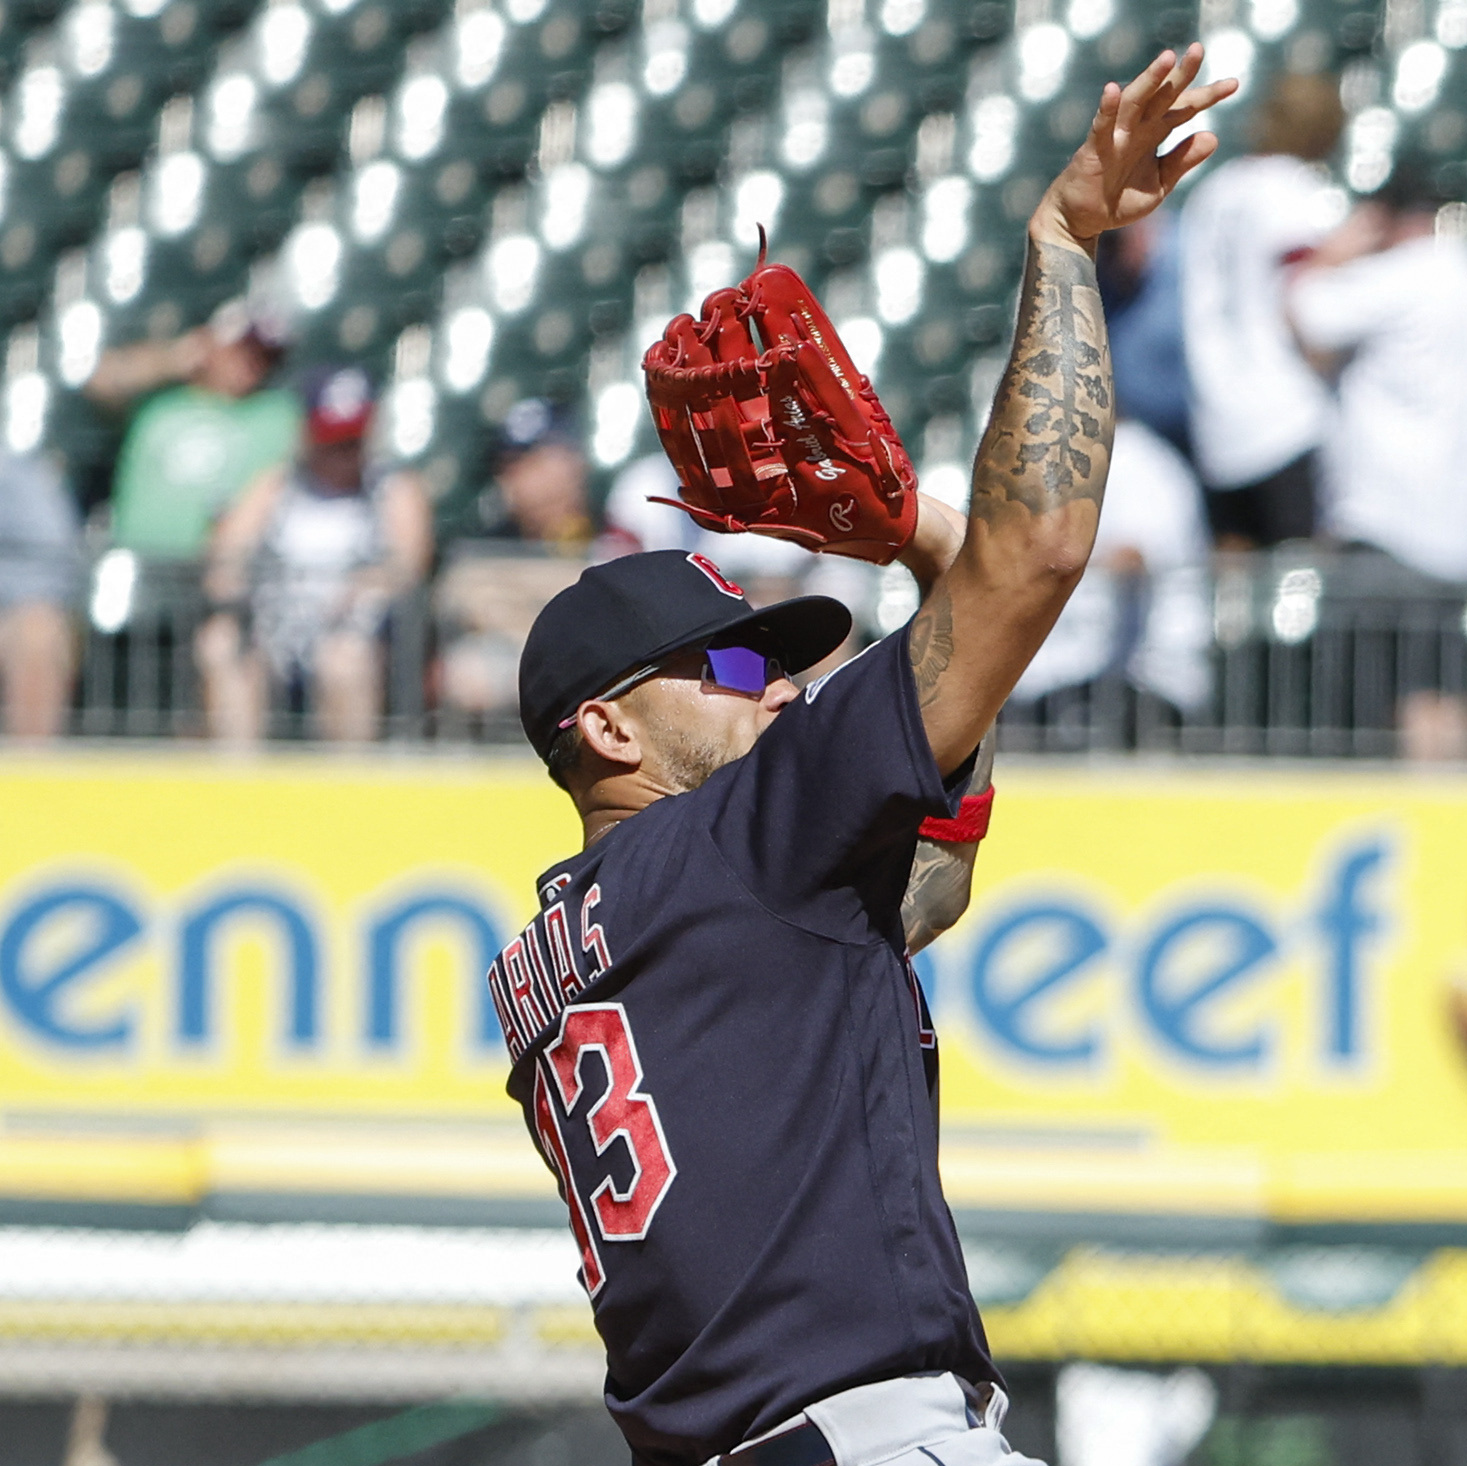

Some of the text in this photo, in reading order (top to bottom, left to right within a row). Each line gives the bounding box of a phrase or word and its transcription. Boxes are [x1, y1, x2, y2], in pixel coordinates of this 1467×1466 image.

[0, 888, 512, 1050] enn
[910, 845, 1385, 1060] eef
[487, 883, 612, 1066] ARIAS
